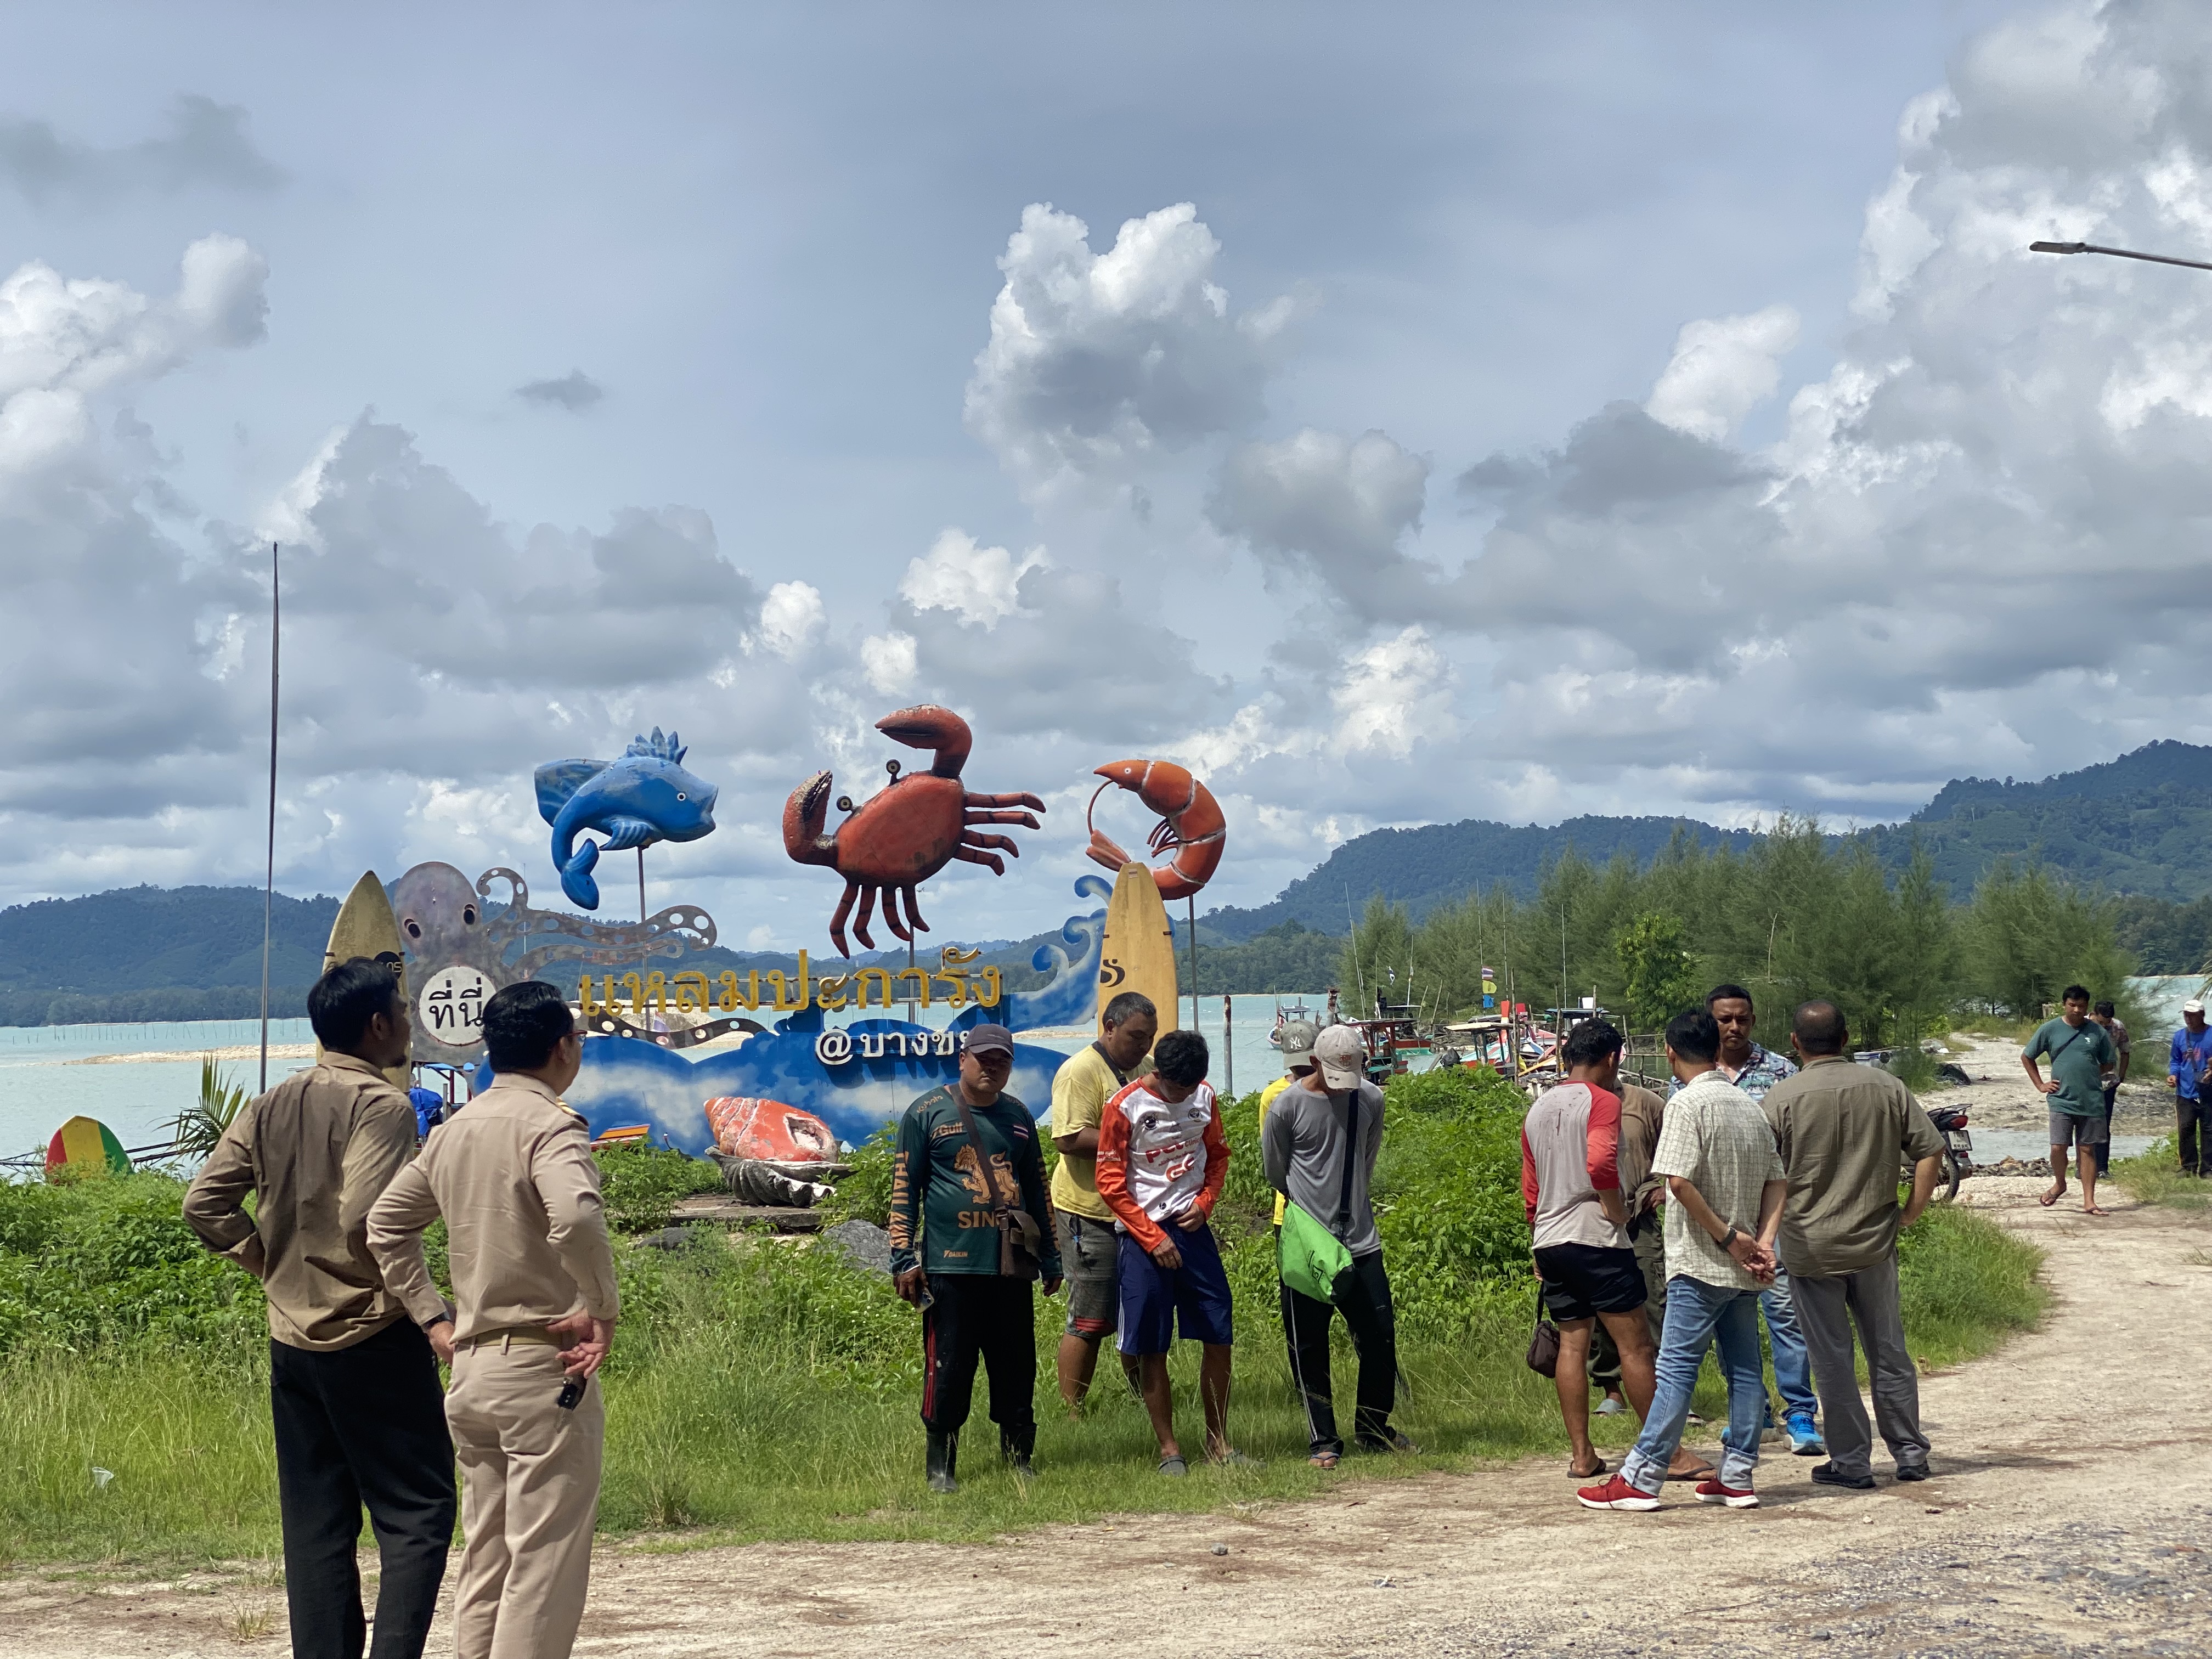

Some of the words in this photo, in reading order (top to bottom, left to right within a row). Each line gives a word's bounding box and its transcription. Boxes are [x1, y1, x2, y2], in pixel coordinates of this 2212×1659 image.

[428, 977, 483, 1029] ที่นี่
[582, 947, 1000, 1017] แหลมปะการัง
[1289, 1036, 1302, 1049] NY
